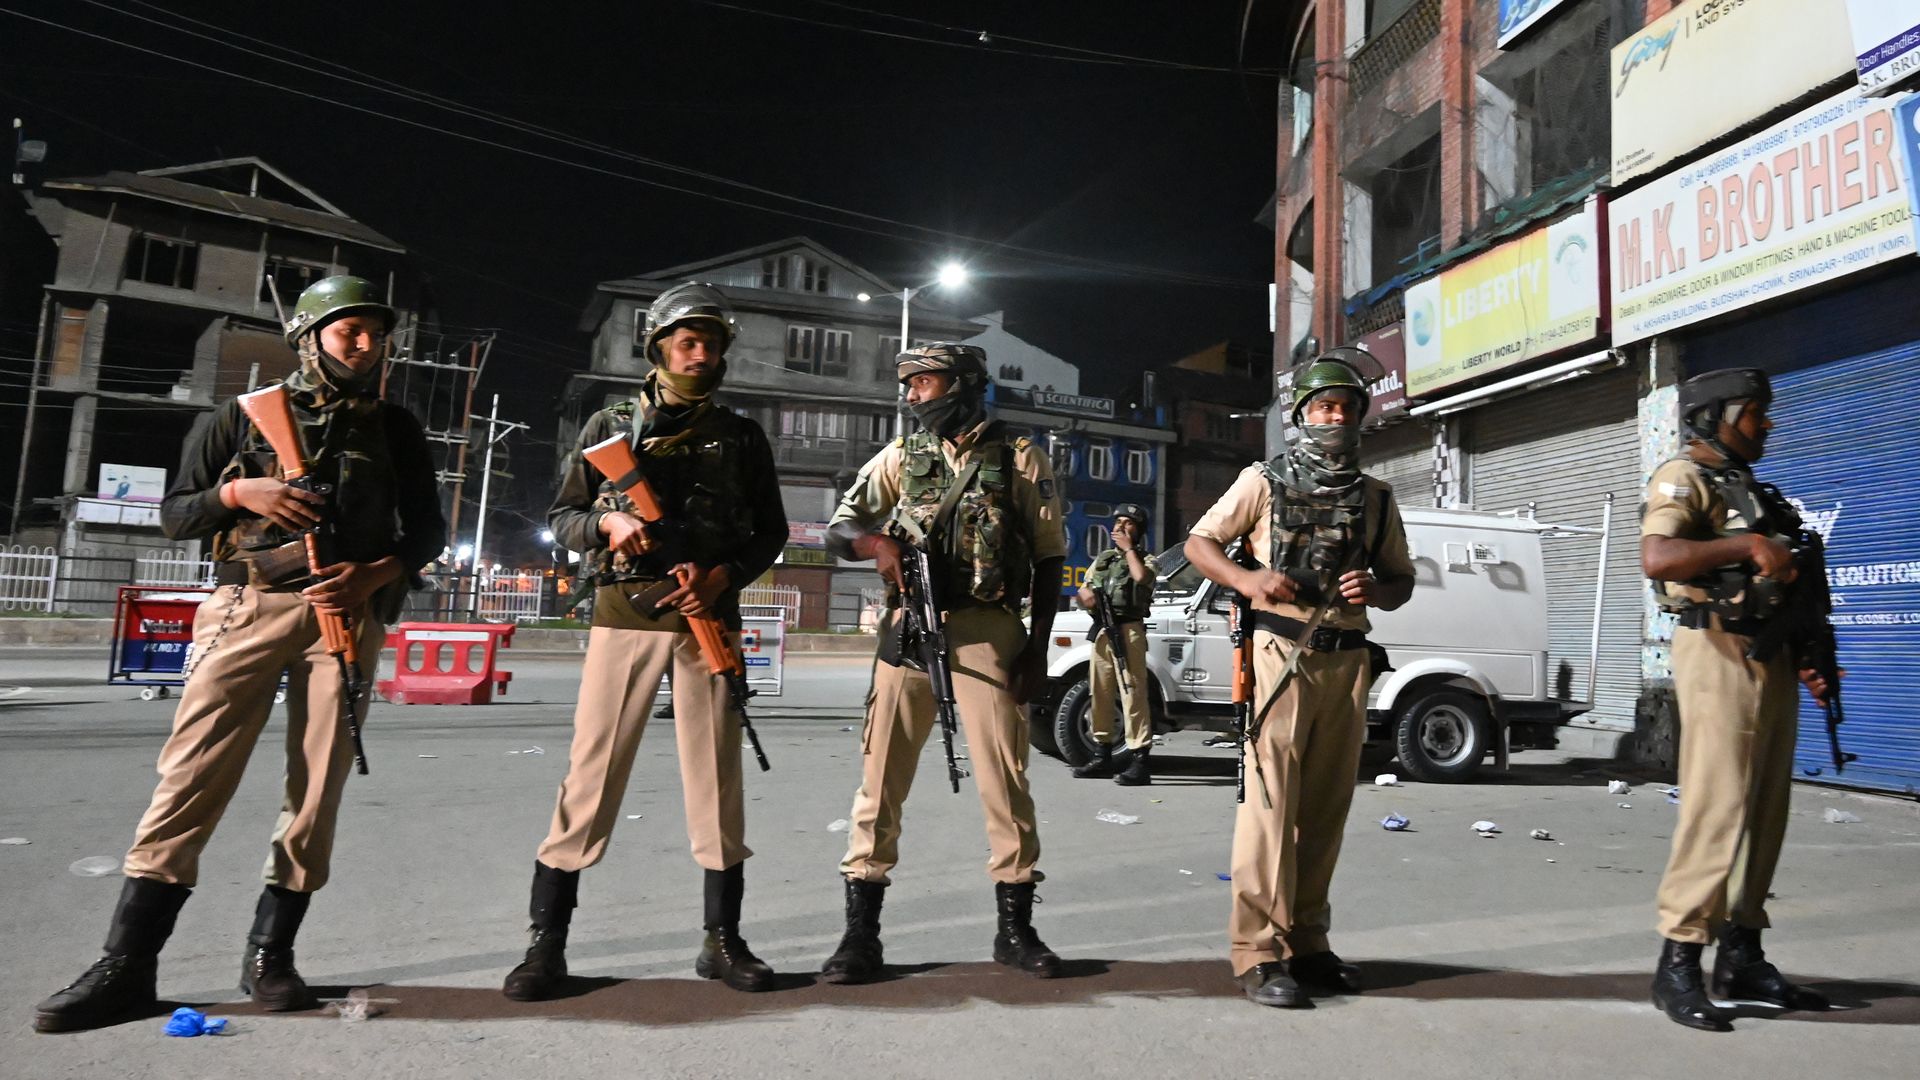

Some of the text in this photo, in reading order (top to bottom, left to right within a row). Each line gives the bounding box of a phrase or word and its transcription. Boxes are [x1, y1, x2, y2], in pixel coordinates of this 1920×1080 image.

[1696, 0, 1724, 19] LOC
[1696, 11, 1719, 31] AND
[1858, 31, 1920, 70] Door Handles
[1618, 202, 1686, 292] M.K.
[1696, 108, 1905, 262] BROTHER
[1690, 275, 1712, 294] DOOR
[1713, 273, 1719, 286] &
[1720, 261, 1754, 283] WINDOW
[1798, 237, 1823, 256] HAND
[1825, 234, 1832, 247] &
[1834, 217, 1878, 244] MACHINE
[1444, 259, 1543, 328] LIBERTY
[1462, 352, 1492, 370] LIBERTY
[1494, 341, 1521, 359] WORLD
[1045, 393, 1110, 412] SCIENTIFICA
